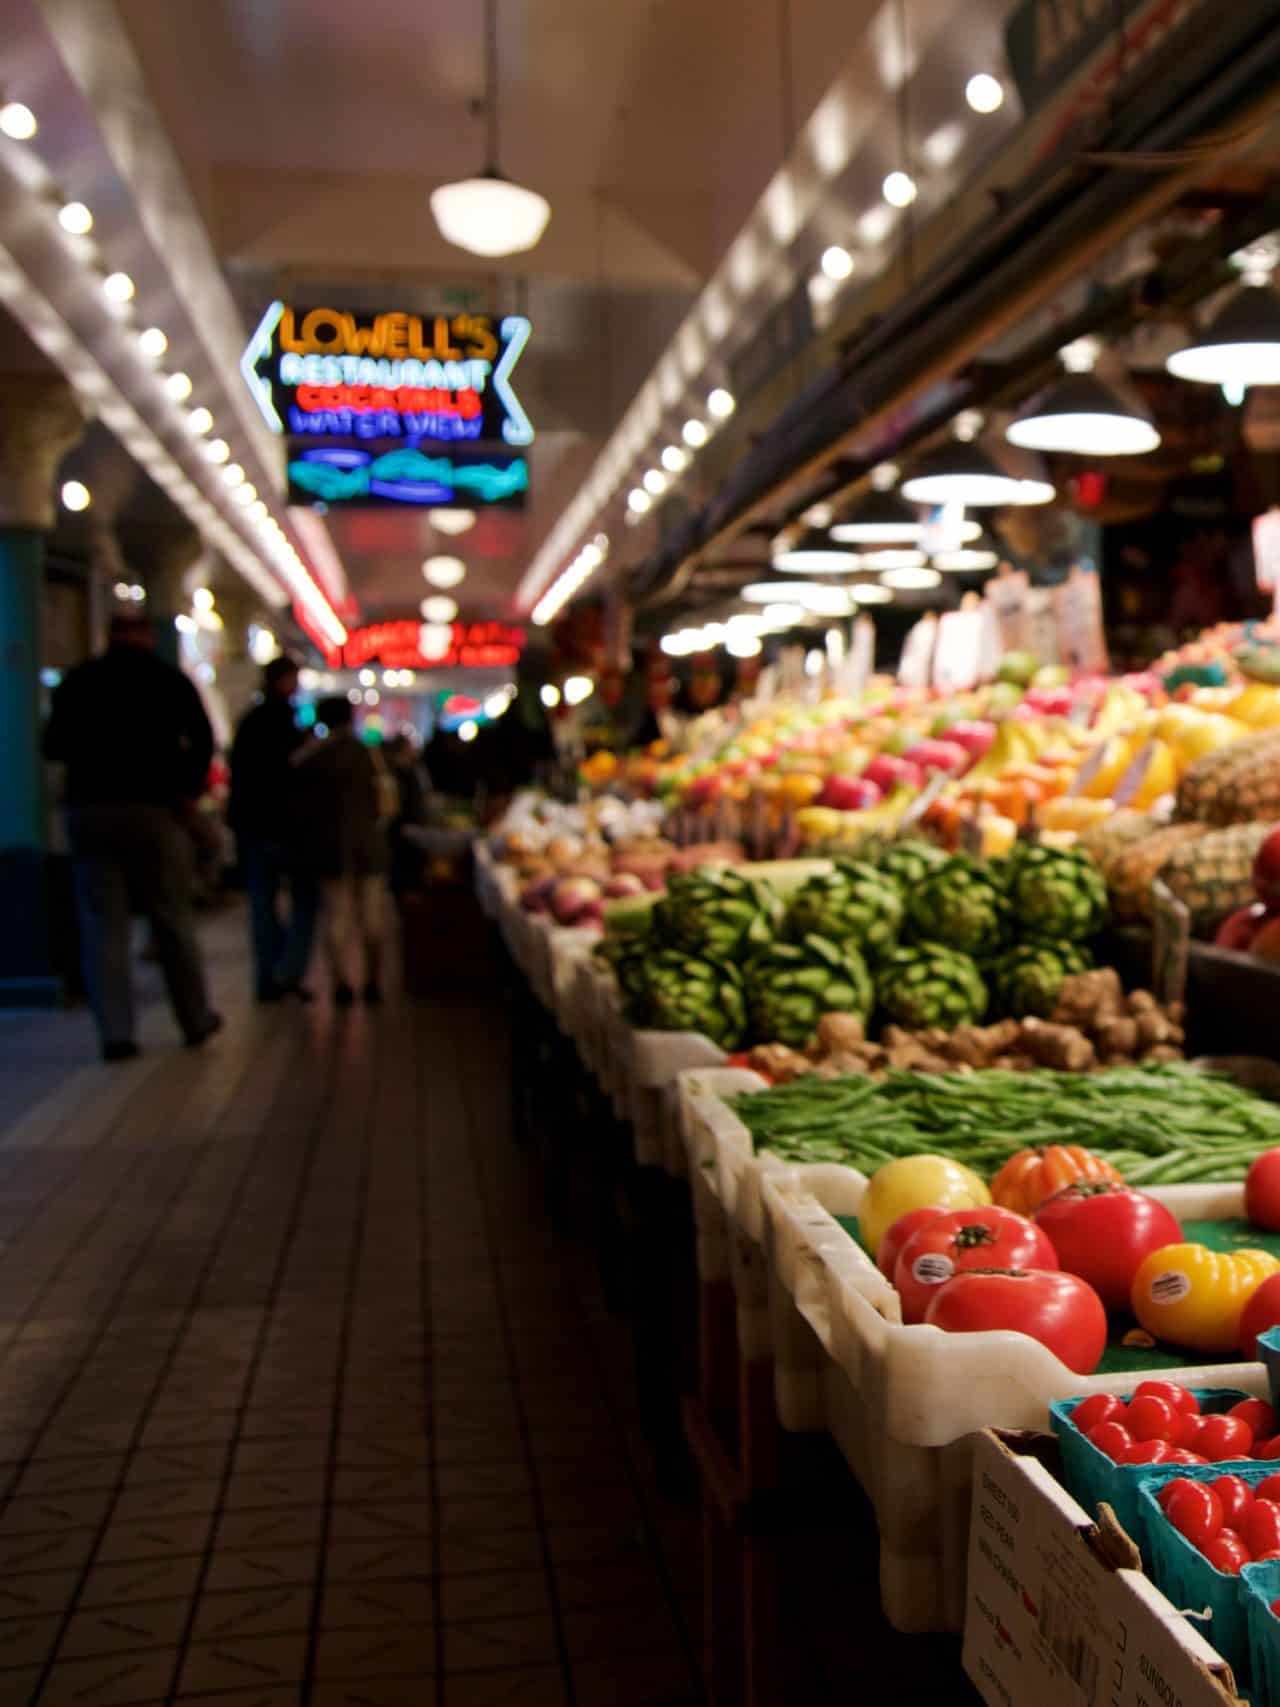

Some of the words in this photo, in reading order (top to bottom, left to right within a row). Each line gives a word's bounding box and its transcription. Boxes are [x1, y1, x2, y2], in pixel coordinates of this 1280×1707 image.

[281, 307, 498, 361] LOWELL'S
[280, 352, 492, 392] RESTAURANT
[289, 404, 403, 439] WATER
[404, 409, 484, 440] VIEW
